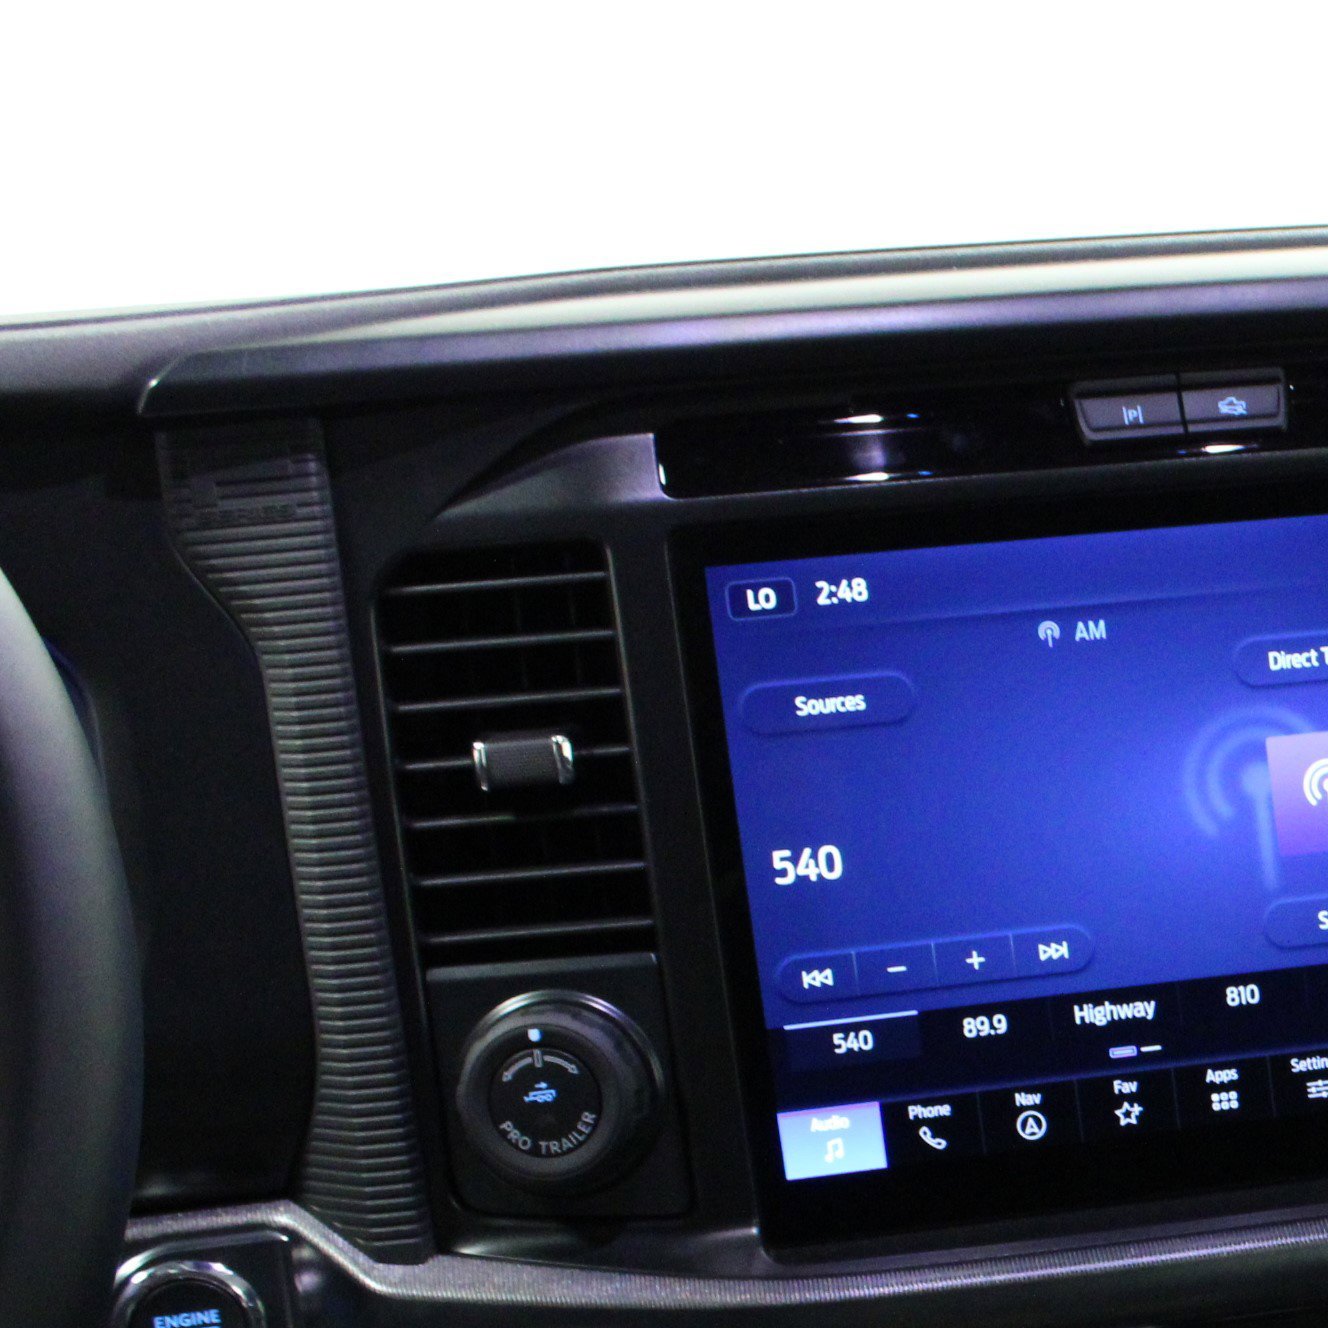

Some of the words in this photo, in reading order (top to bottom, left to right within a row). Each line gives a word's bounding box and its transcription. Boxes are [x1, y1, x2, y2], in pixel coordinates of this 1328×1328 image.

[746, 588, 776, 612] LO
[815, 577, 868, 606] 2:48
[1074, 619, 1107, 641] AM
[1268, 649, 1319, 671] Direct
[794, 692, 866, 716] Sources
[772, 844, 843, 886] 540
[1226, 985, 1260, 1007] 810
[1074, 1000, 1156, 1027] Highway
[962, 1014, 1008, 1039] 89.9
[832, 1030, 874, 1054] 540
[1113, 1079, 1138, 1096] Fav
[1205, 1067, 1239, 1086] Apps
[1014, 1090, 1043, 1107] Nav
[810, 1115, 850, 1133] Audio
[908, 1104, 952, 1121] Phone
[500, 1120, 532, 1150] PRO
[538, 1111, 597, 1155] TRAILER
